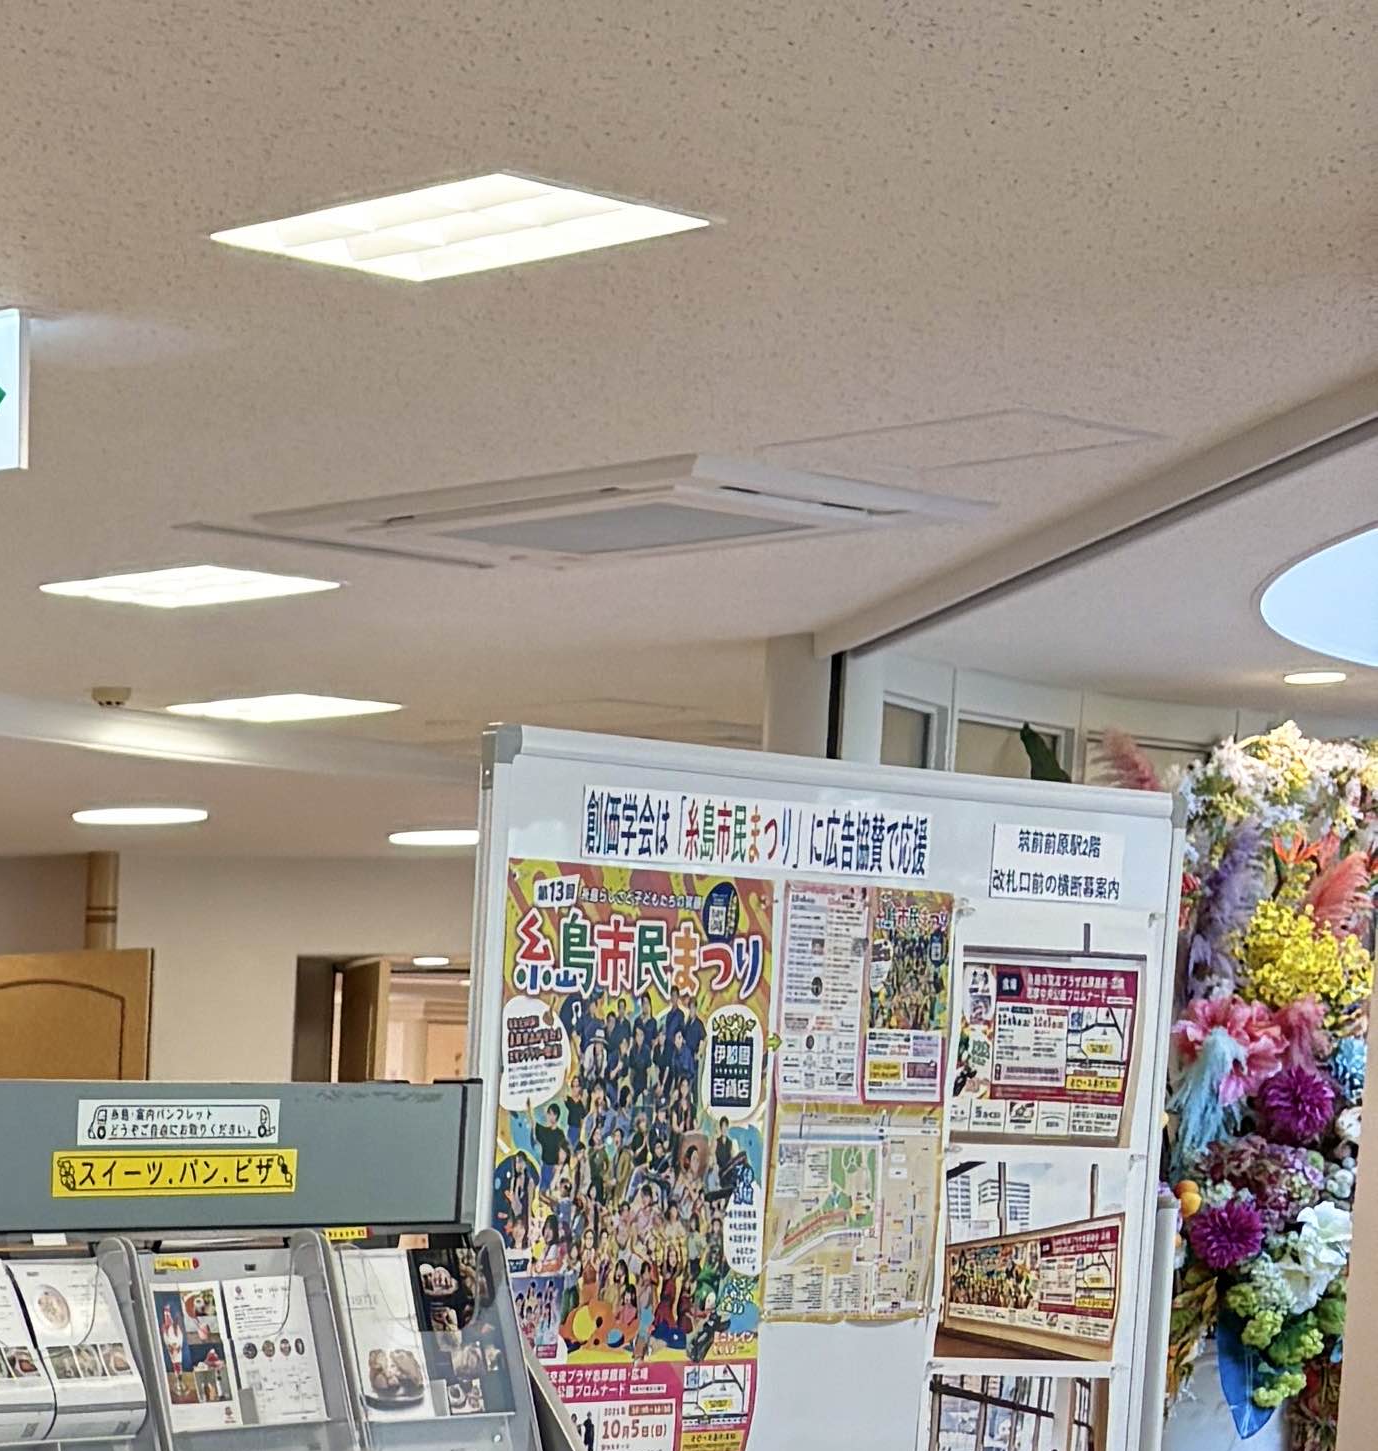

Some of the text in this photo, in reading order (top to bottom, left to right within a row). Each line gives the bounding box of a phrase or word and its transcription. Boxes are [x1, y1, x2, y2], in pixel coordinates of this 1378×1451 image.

[585, 788, 930, 877] 創価学会は「糸島市民まつり」に広告協賛で応援
[1017, 828, 1102, 859] 筑前前原駅2階
[513, 906, 764, 1000] 糸島市民まつり
